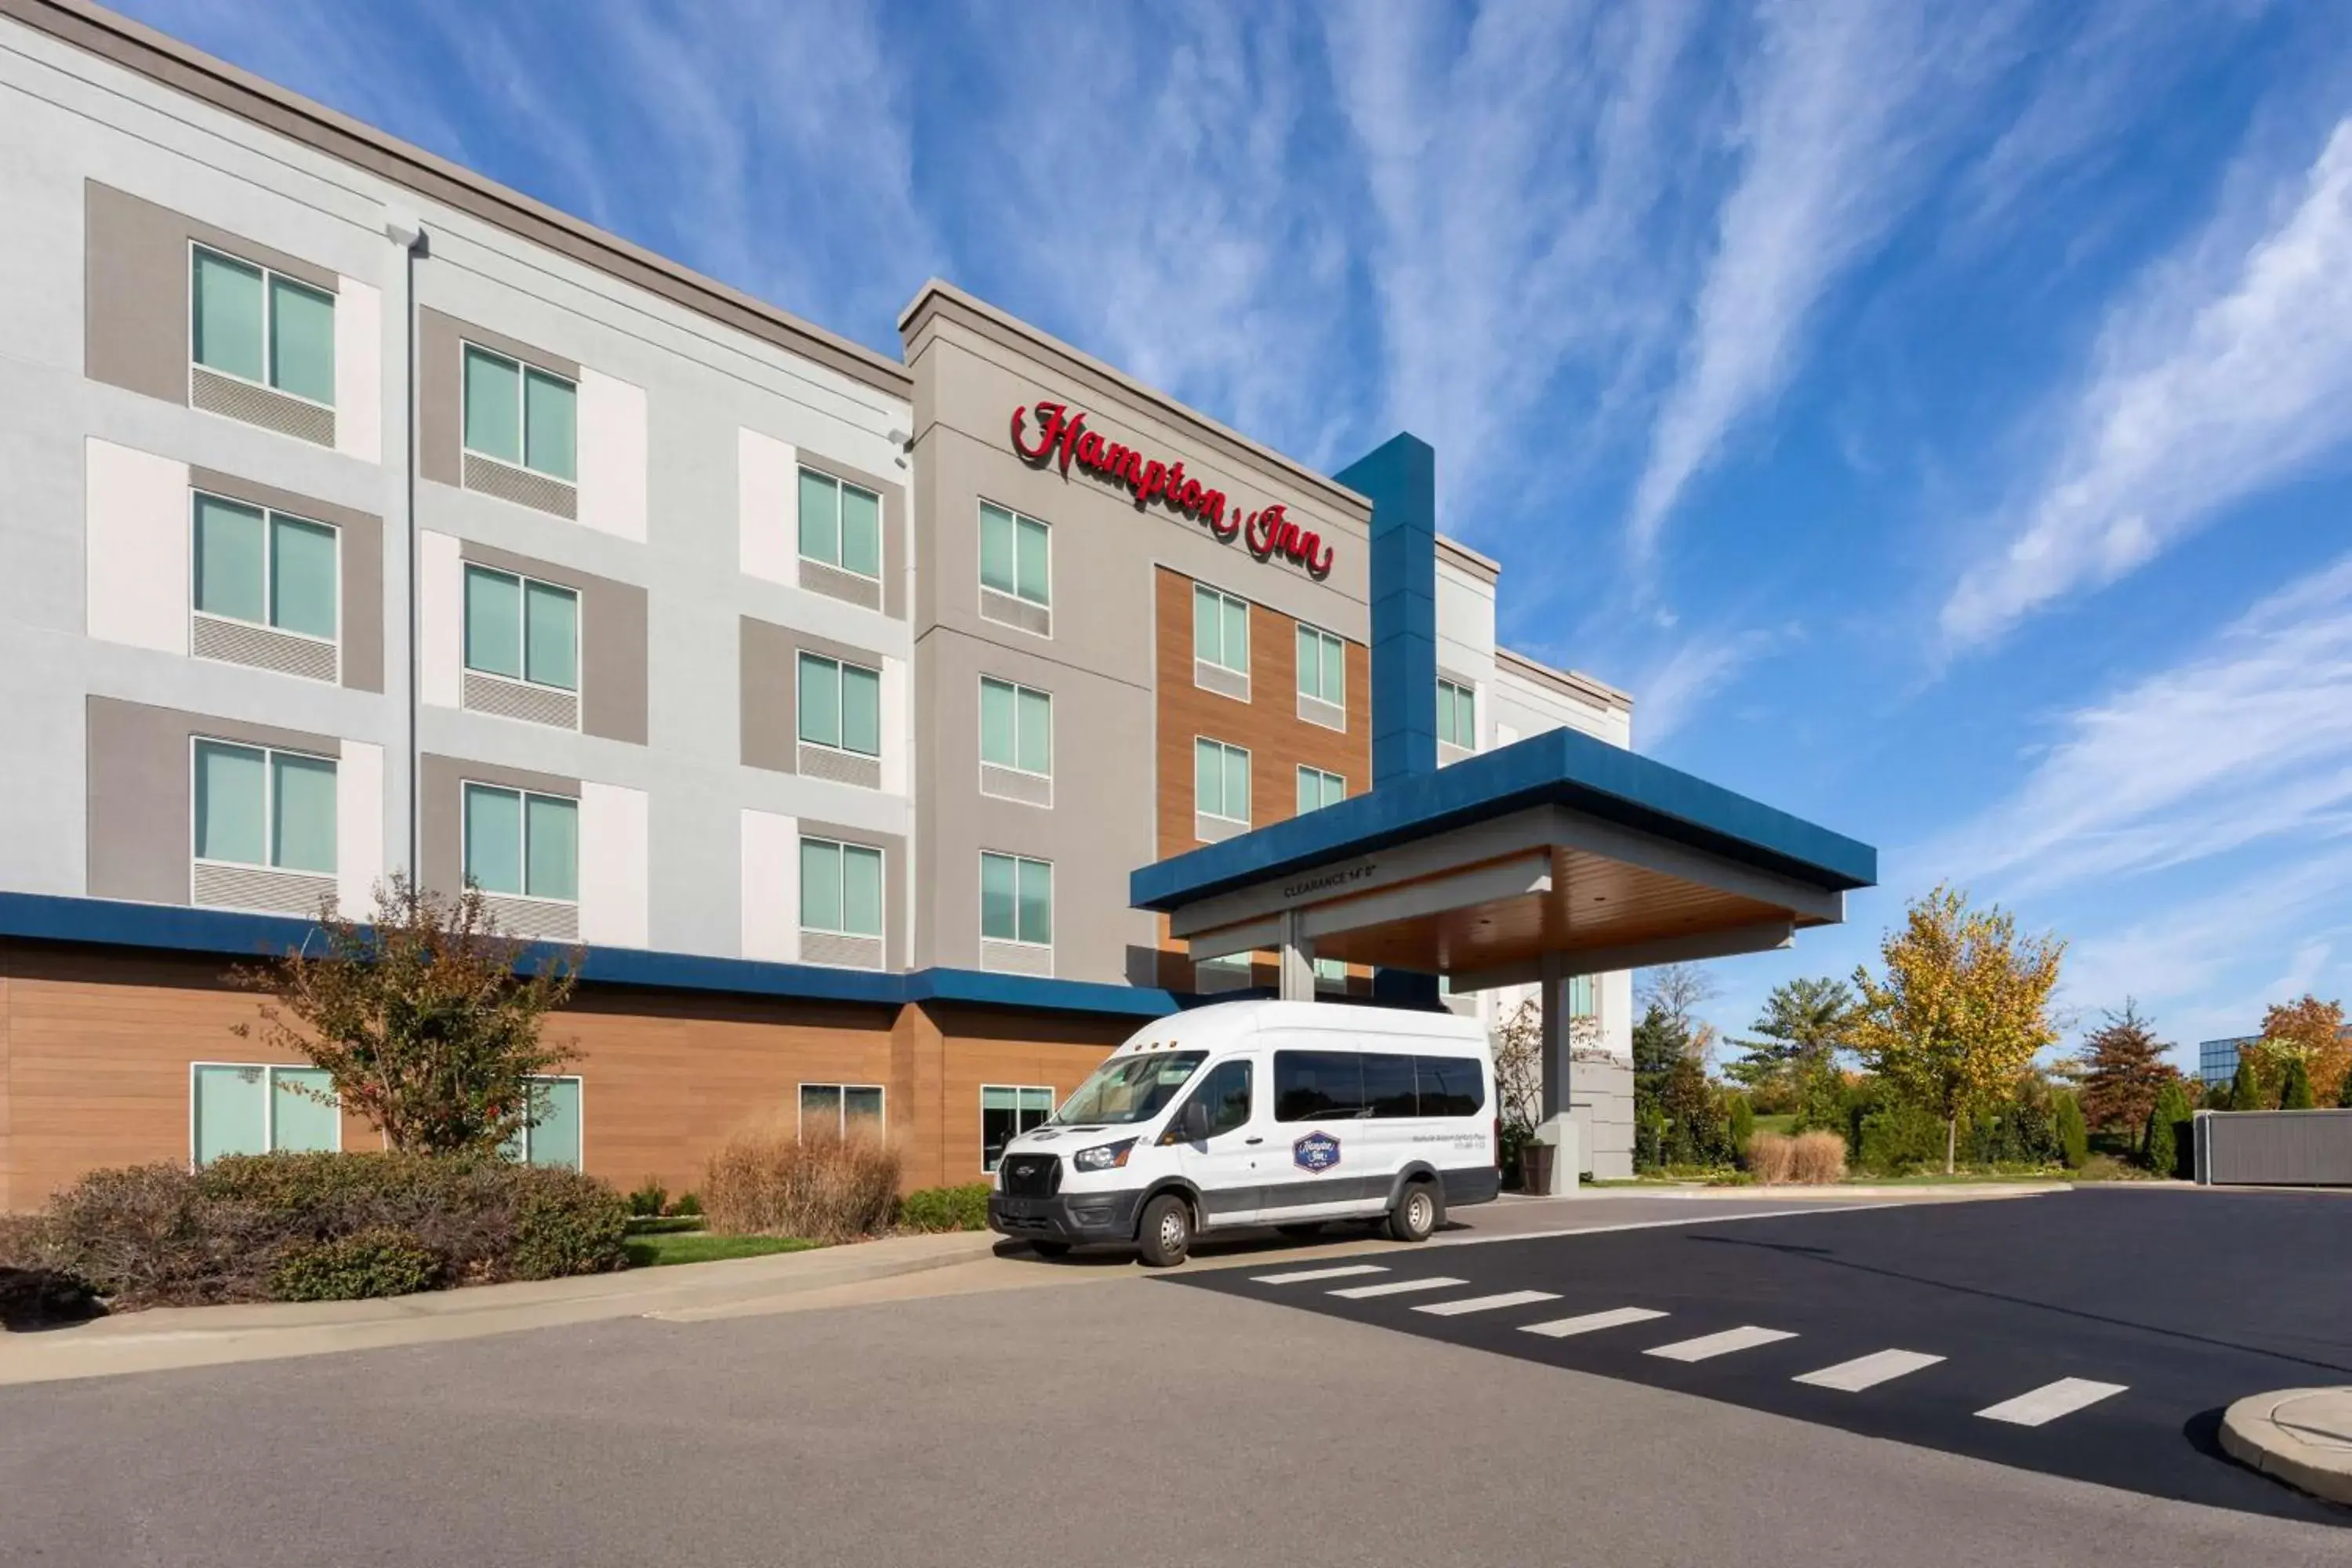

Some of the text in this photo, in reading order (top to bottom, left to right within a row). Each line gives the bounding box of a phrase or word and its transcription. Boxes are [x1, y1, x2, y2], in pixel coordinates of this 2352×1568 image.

[1011, 401, 1334, 572] Hampton Inn
[1283, 872, 1346, 898] CLEARANCE
